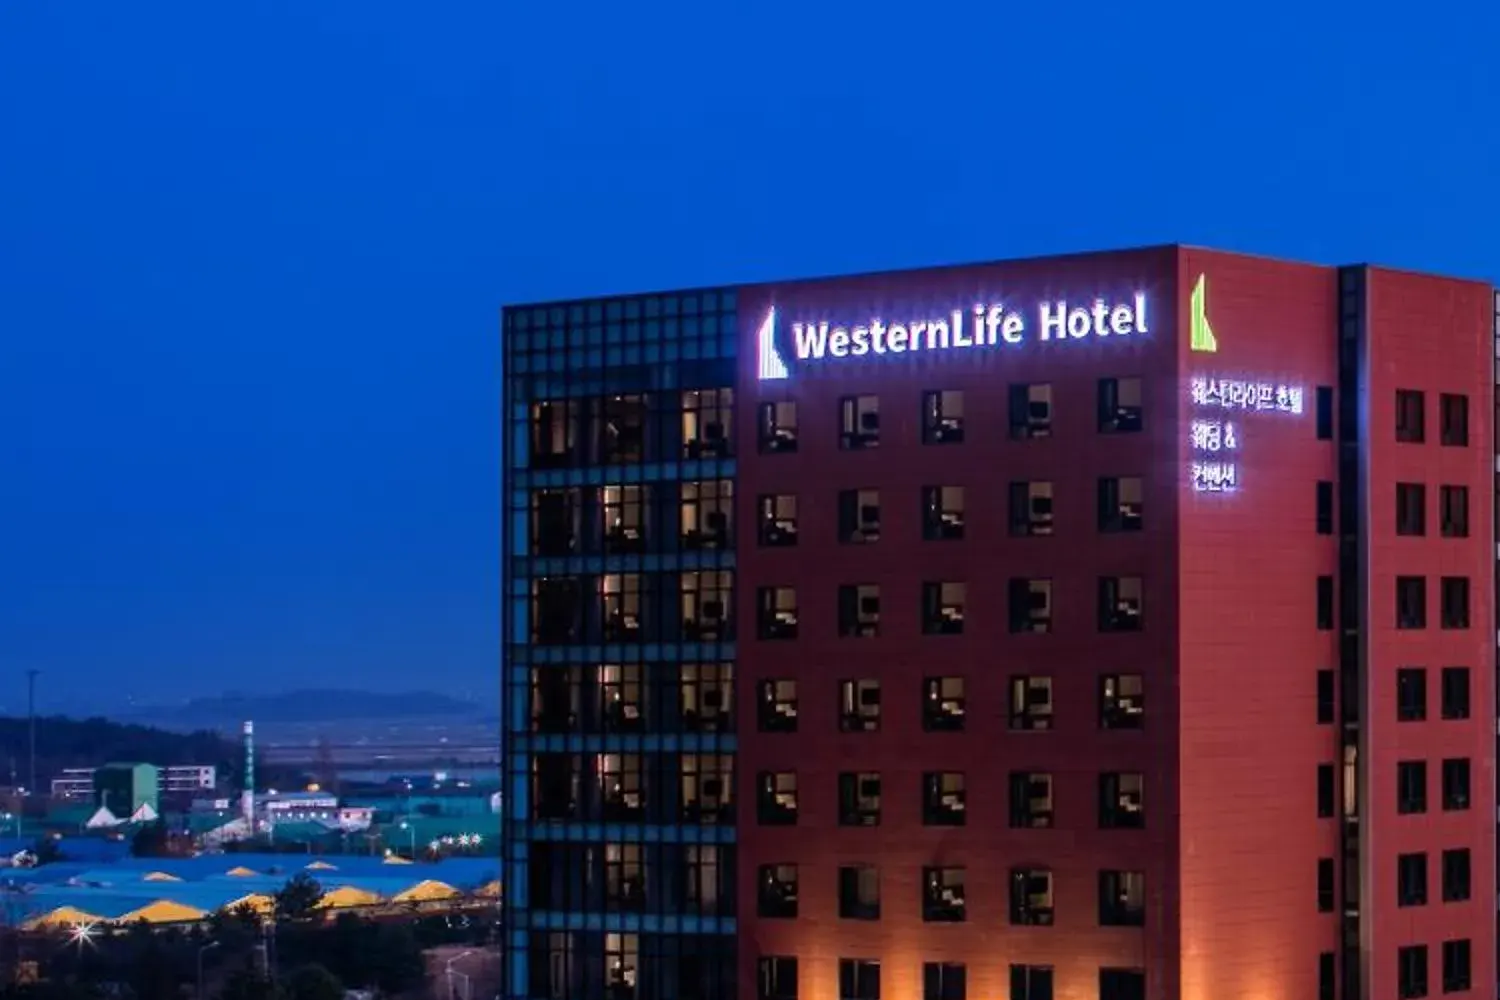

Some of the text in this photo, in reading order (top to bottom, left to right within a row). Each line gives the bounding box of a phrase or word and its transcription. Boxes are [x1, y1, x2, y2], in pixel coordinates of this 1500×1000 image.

[794, 293, 1148, 360] WesternLife Hotel
[1225, 421, 1236, 449] &
